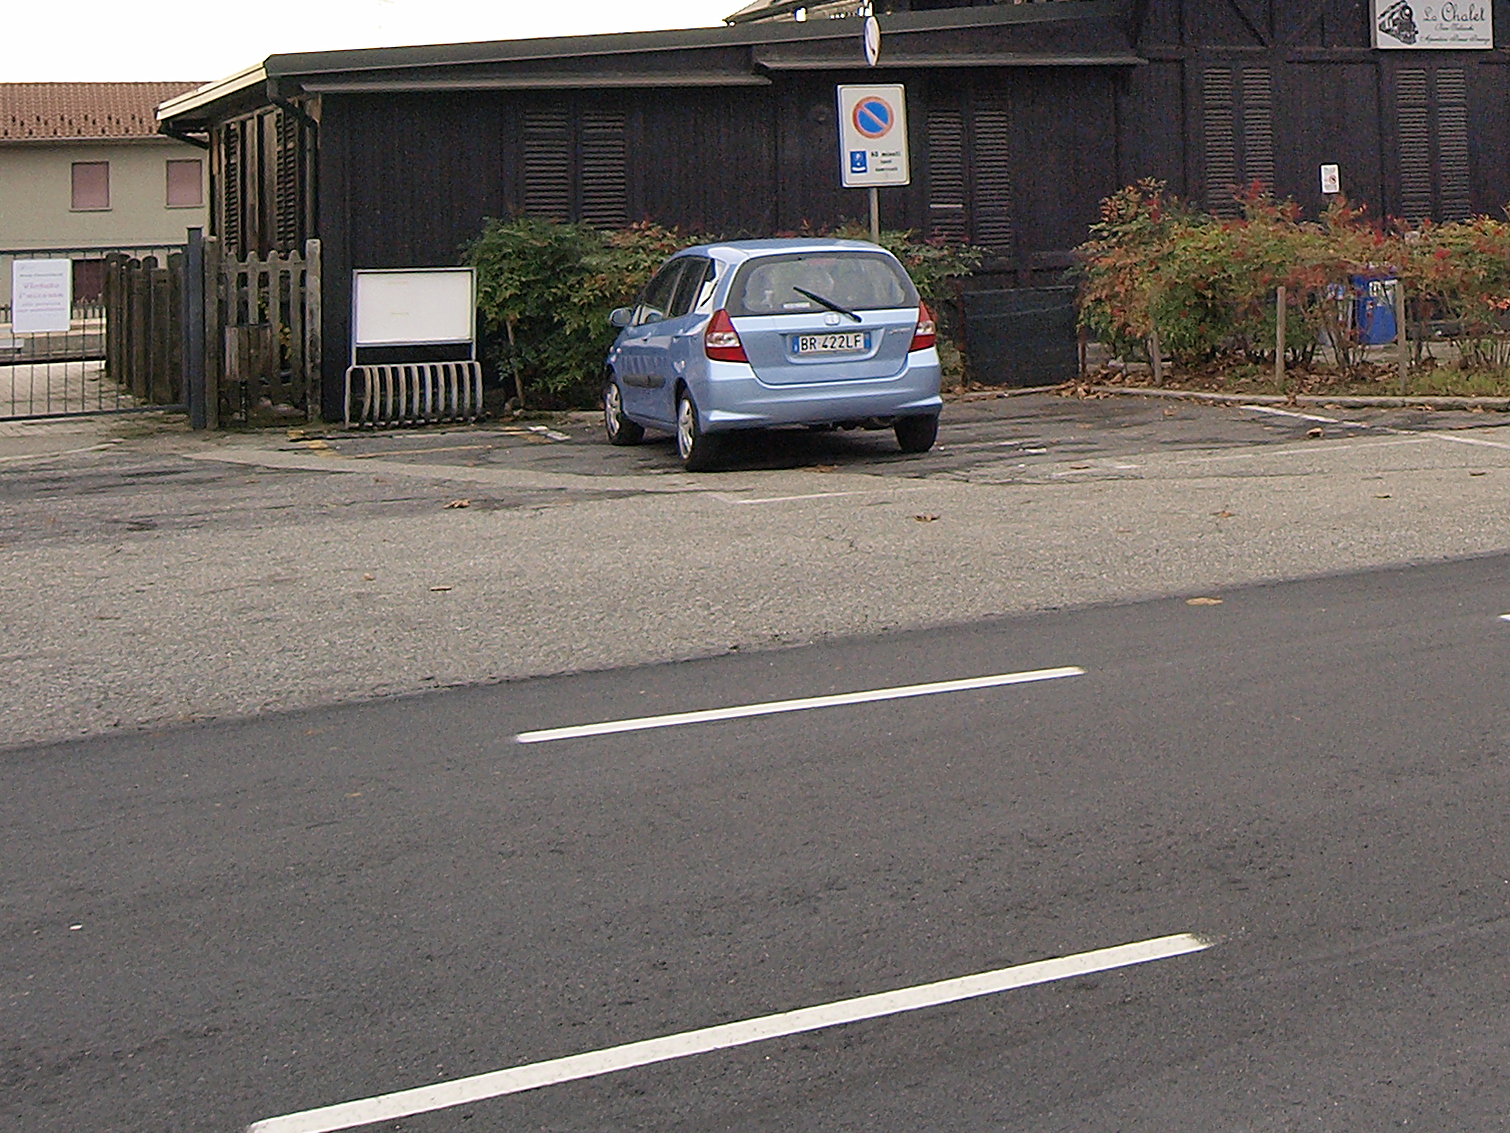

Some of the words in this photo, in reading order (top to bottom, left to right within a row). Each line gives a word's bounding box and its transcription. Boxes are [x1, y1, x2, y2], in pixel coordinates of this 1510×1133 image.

[1441, 1, 1485, 22] Chalet
[801, 337, 817, 351] BR
[821, 334, 861, 349] 422LF
